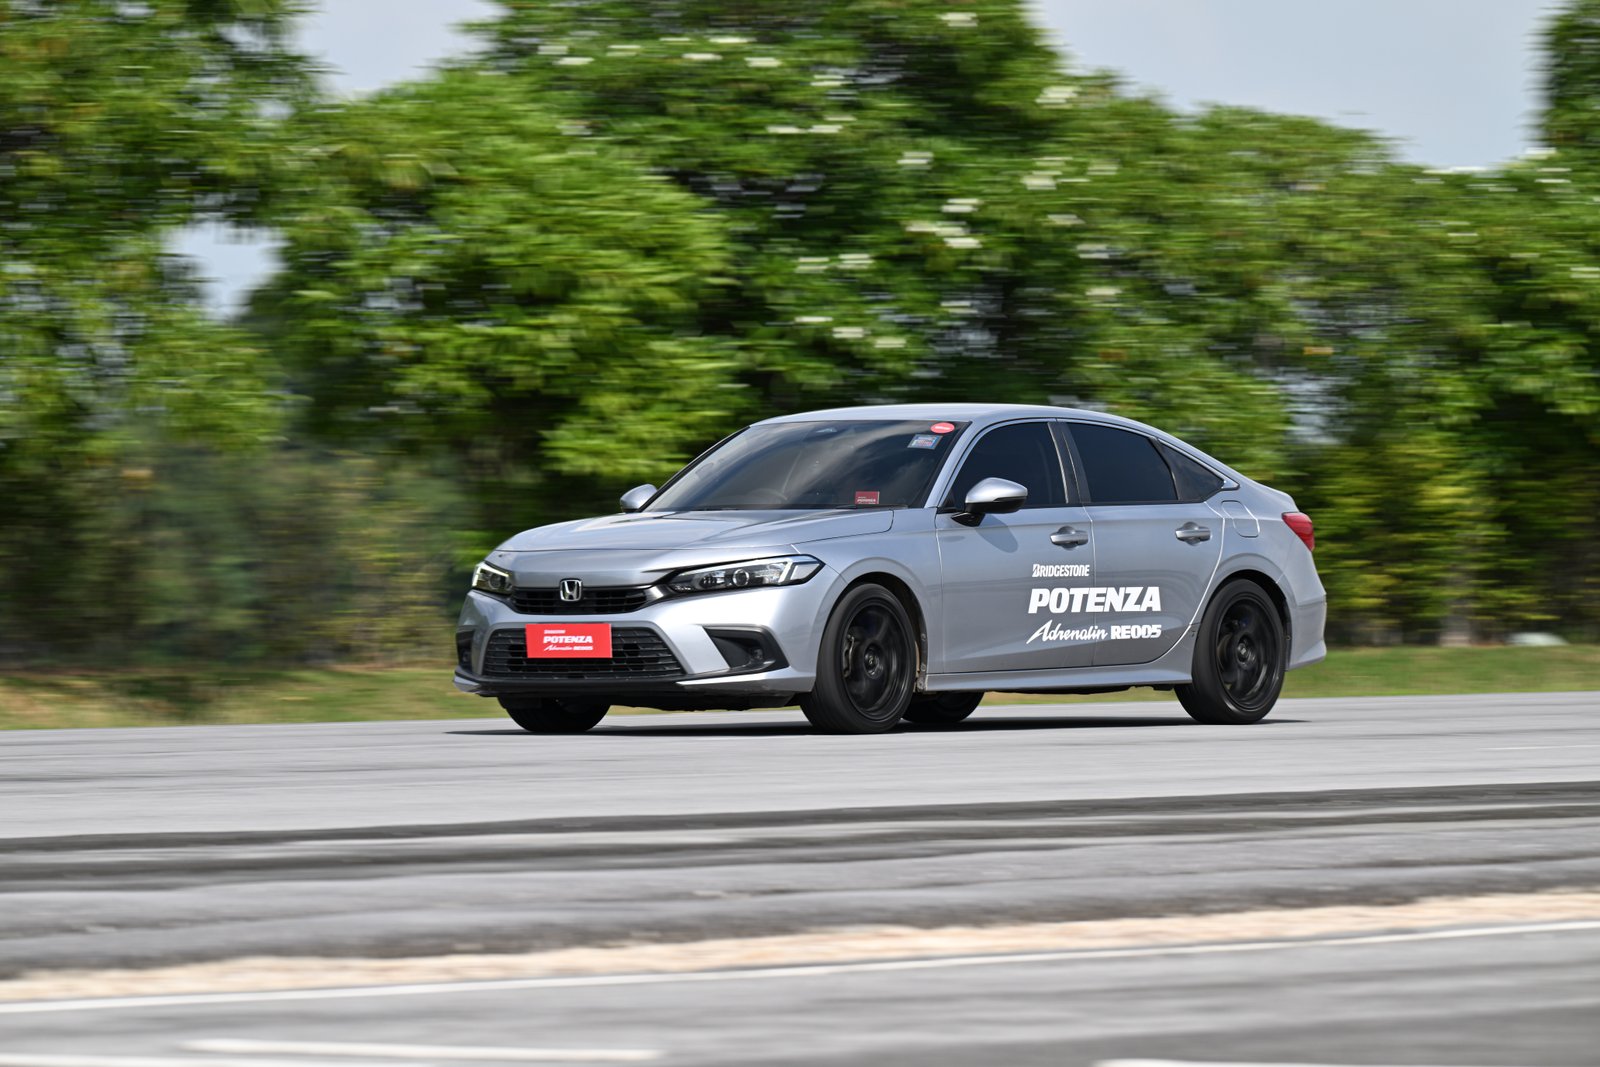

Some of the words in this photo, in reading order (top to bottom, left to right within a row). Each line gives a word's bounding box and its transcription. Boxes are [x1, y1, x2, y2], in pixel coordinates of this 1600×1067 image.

[1032, 564, 1090, 578] BRIDGESTONE
[1028, 586, 1161, 614] POTENZA
[543, 635, 593, 644] POTENZA
[1026, 619, 1108, 645] Adrenalin
[1110, 624, 1162, 640] RE005
